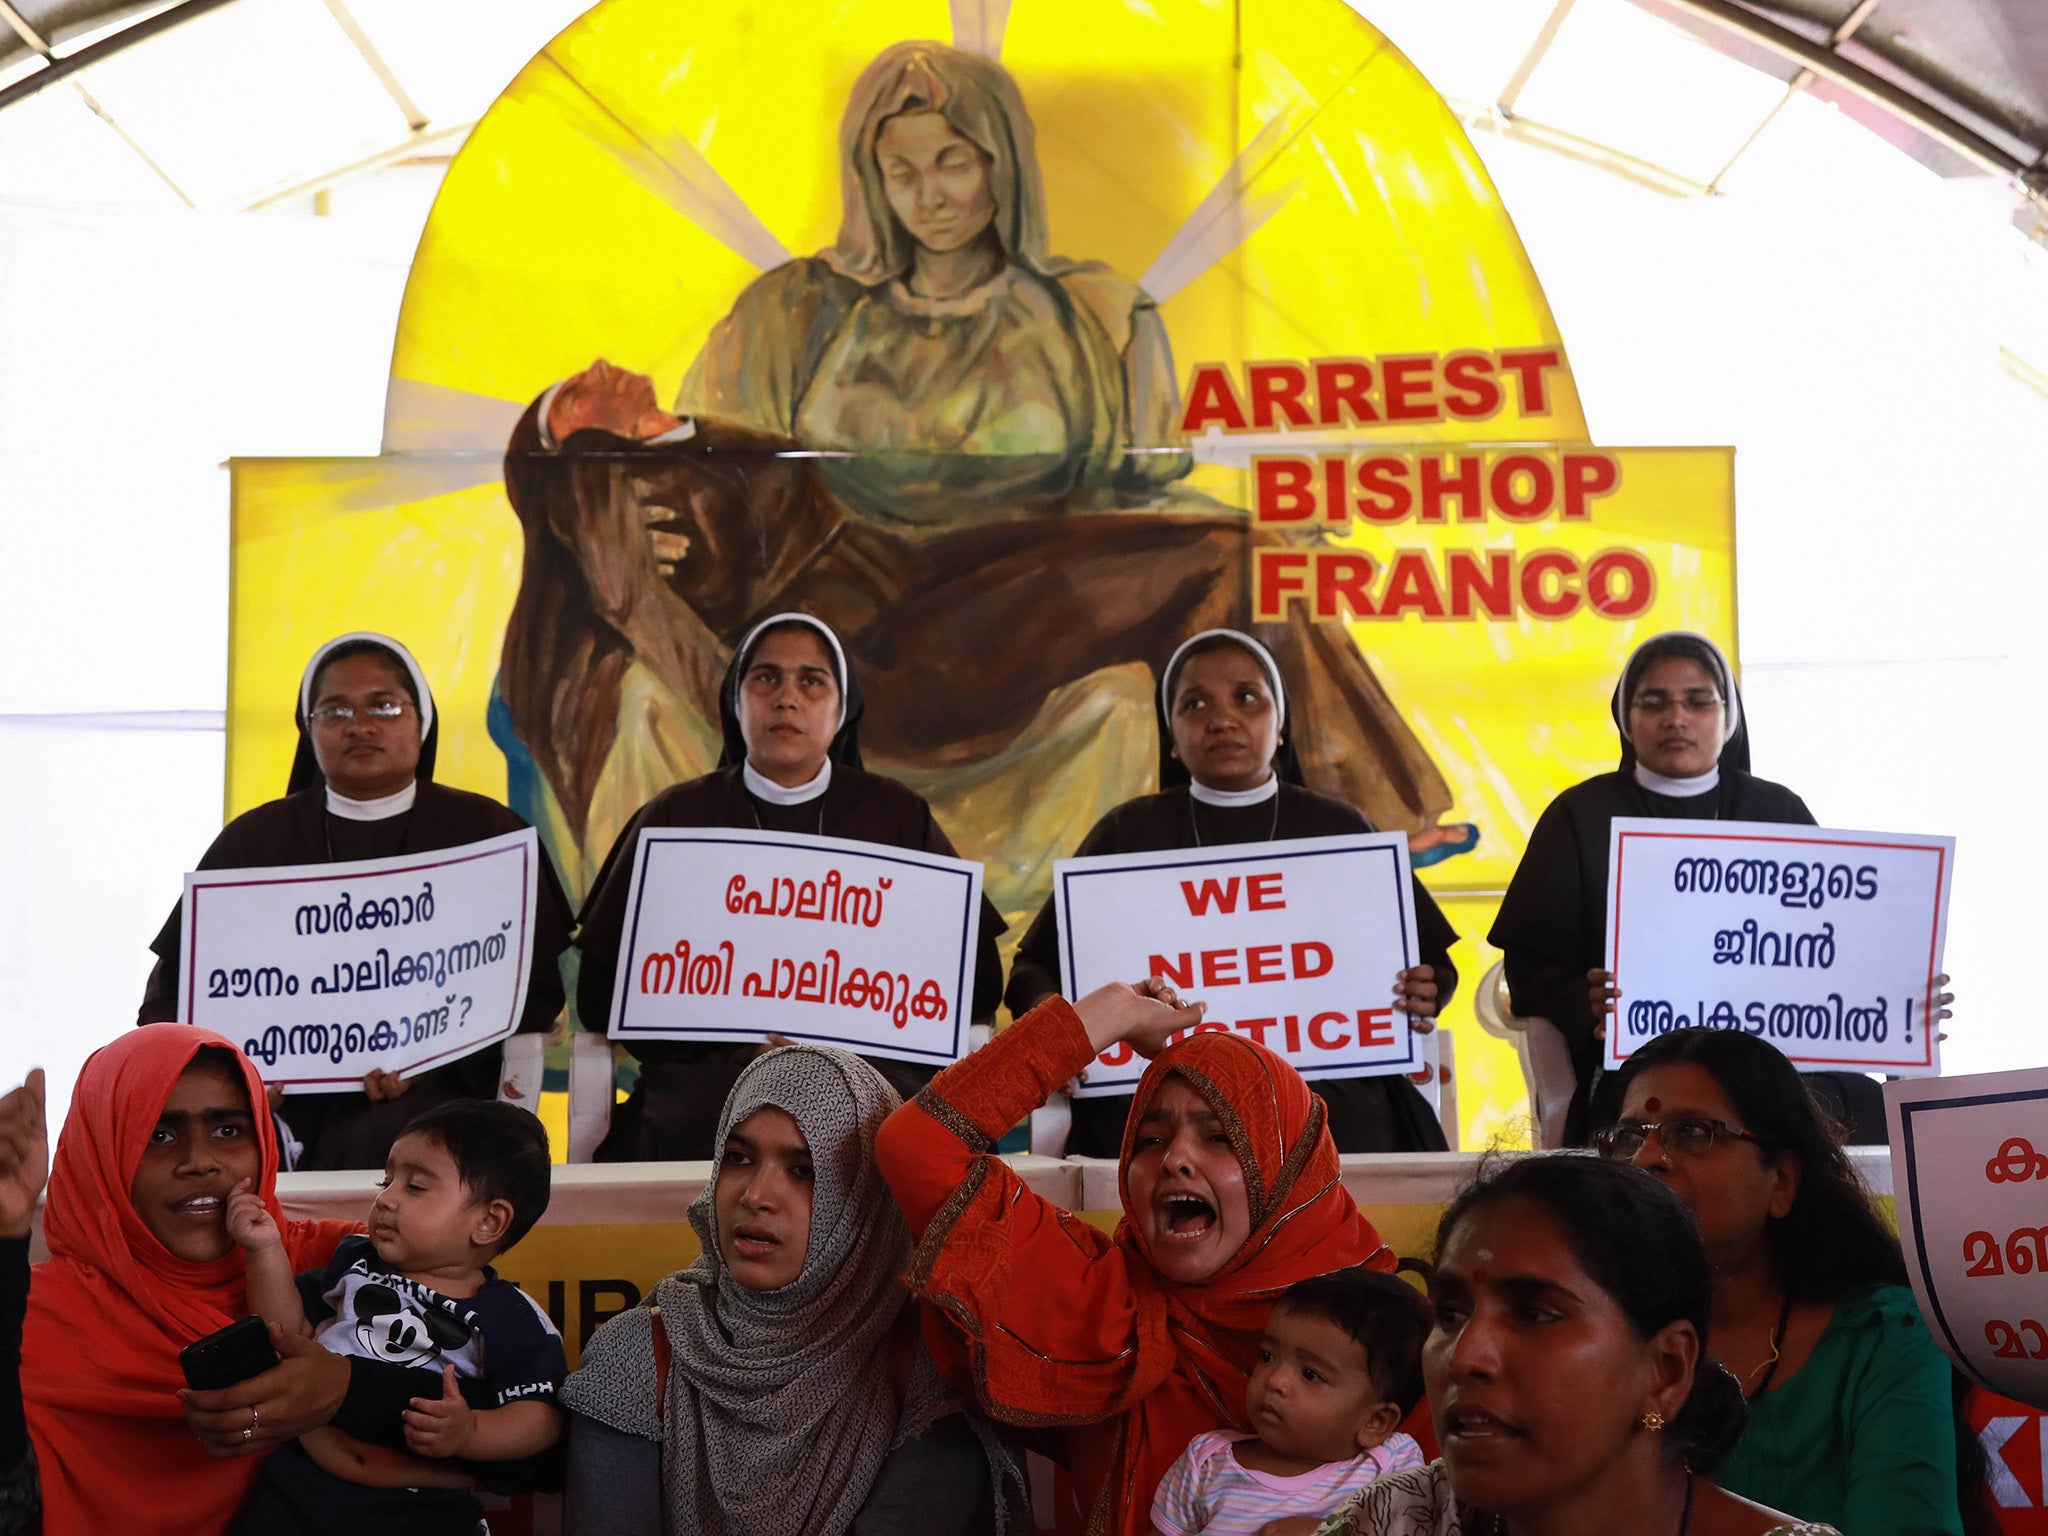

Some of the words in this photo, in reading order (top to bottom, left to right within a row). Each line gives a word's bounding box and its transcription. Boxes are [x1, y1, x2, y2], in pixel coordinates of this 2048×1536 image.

[1180, 347, 1561, 433] ARREST
[1255, 452, 1619, 524] BISHOP
[1257, 550, 1654, 618] FRANCO
[295, 881, 435, 936] സർക്കാർ
[725, 869, 893, 928] പോലീസ്
[1180, 872, 1287, 917] WE
[1674, 857, 1879, 909] ഞങ്ങളുടെ
[310, 920, 513, 995] പാലിക്കുന്നത്
[1148, 940, 1334, 990] NEED
[1713, 918, 1836, 970] ജീവൻ
[640, 939, 735, 997] നീതി
[742, 948, 949, 1030] പാലിക്കുക
[1098, 1007, 1396, 1068] JTICE
